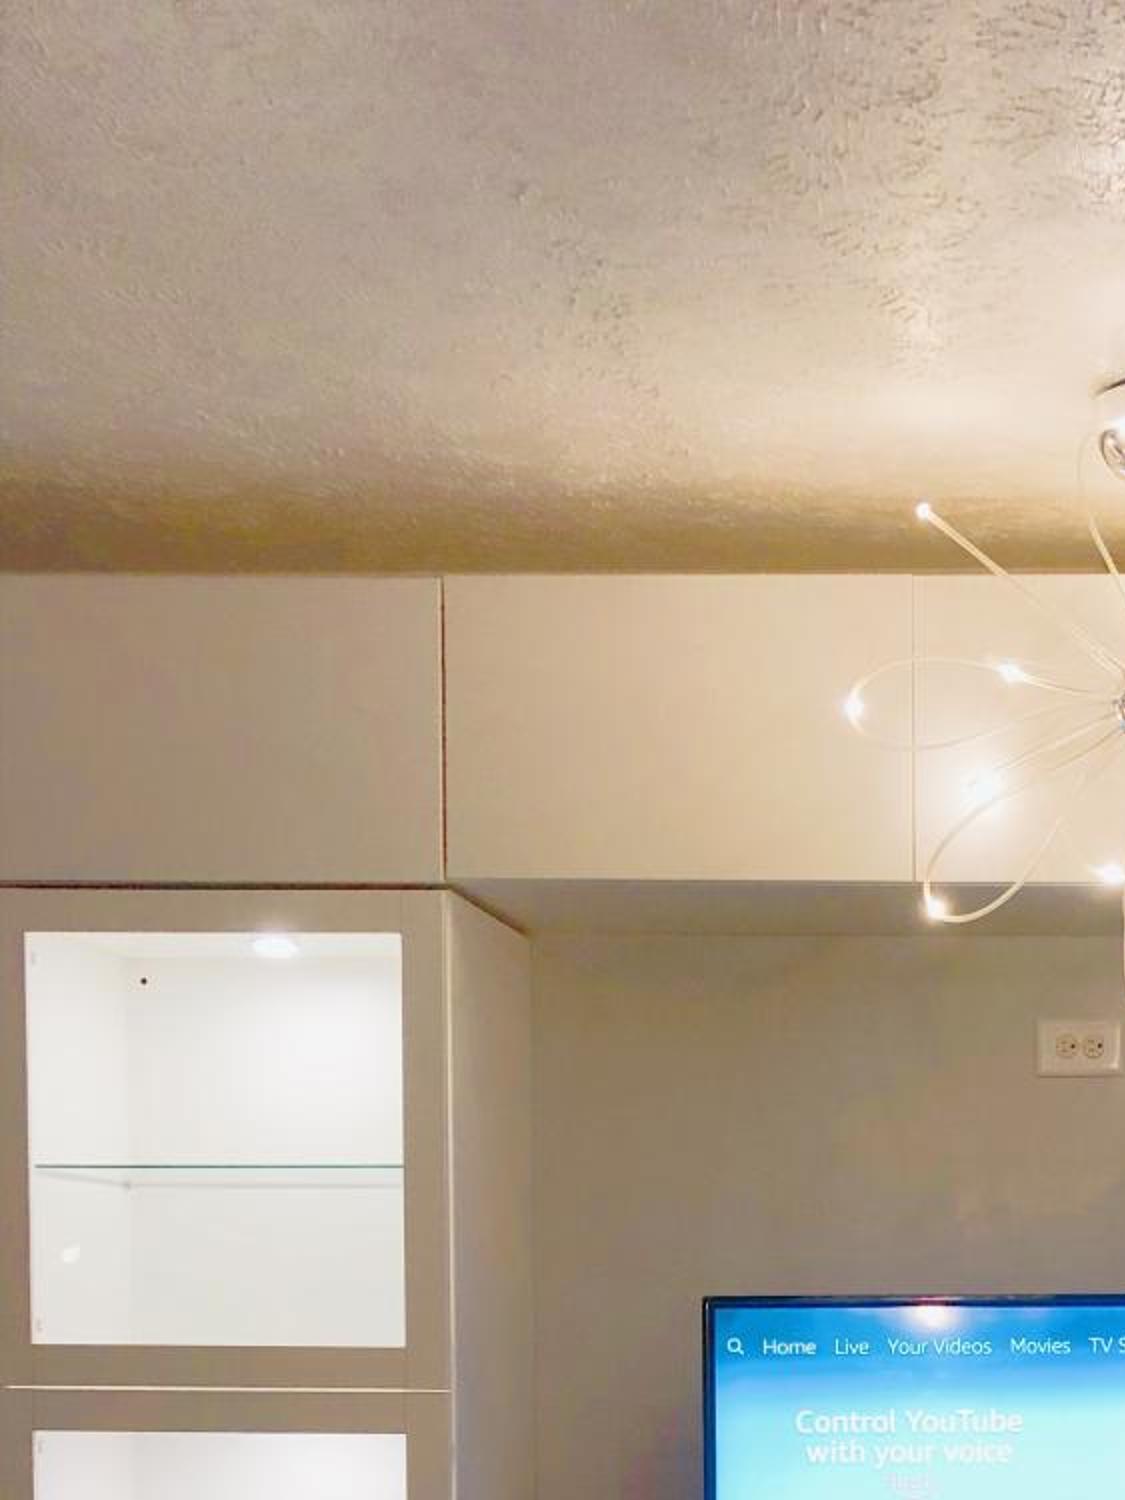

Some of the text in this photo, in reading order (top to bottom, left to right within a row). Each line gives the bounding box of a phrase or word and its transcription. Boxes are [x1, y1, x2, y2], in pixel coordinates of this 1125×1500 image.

[763, 1339, 817, 1355] Home
[834, 1338, 870, 1356] Live
[888, 1338, 993, 1356] Your Videos
[1010, 1337, 1071, 1354] Movies
[1089, 1337, 1114, 1353] TV
[796, 1410, 1023, 1434] Control YouTube
[807, 1440, 1014, 1469] with your voice
